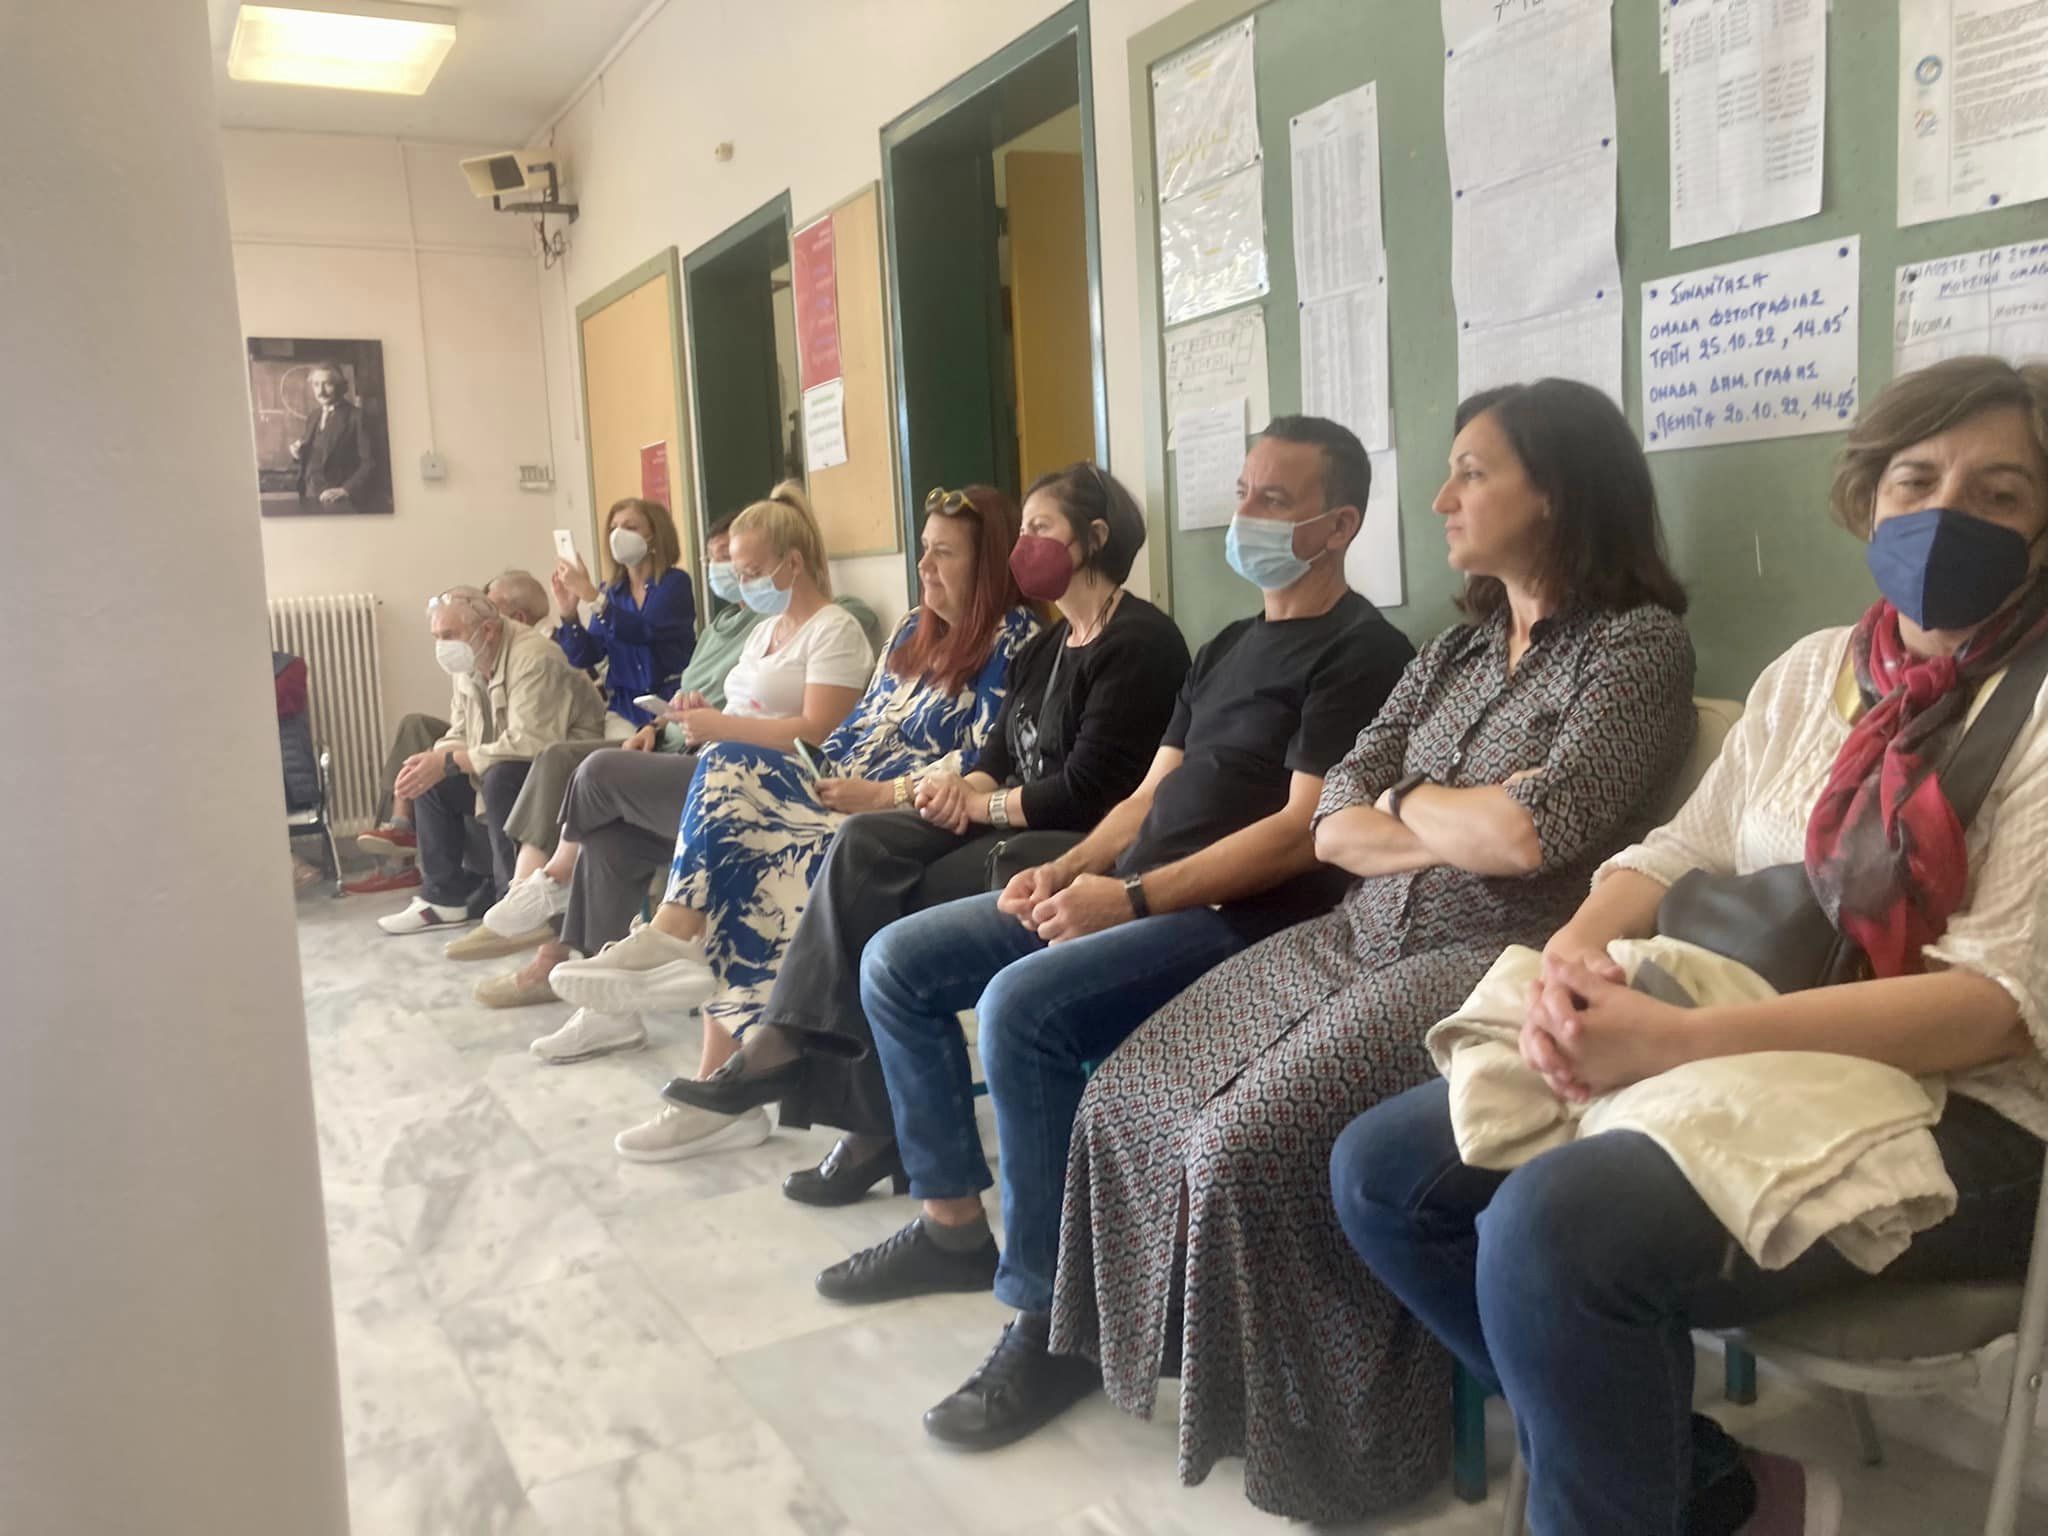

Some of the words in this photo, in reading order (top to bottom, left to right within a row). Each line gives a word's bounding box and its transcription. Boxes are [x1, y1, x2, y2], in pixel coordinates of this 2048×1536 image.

[1670, 272, 1769, 306] ΣΥΝΑΝΤΗΣΗ
[1650, 318, 1700, 340] ΟΜΑΔΑ
[1709, 288, 1824, 327] ΦΩΤΟΓΡΑΦΙΑΣ
[1650, 341, 1690, 369] ΤΡΙΤΗ
[1650, 381, 1698, 403] ΟΜΑΔΑ
[1710, 373, 1750, 394] ΔΗΜ.
[1753, 360, 1820, 387] ΓΡΑΦΗΣ
[1655, 406, 1715, 439] ΠΕΜΠΤΗ
